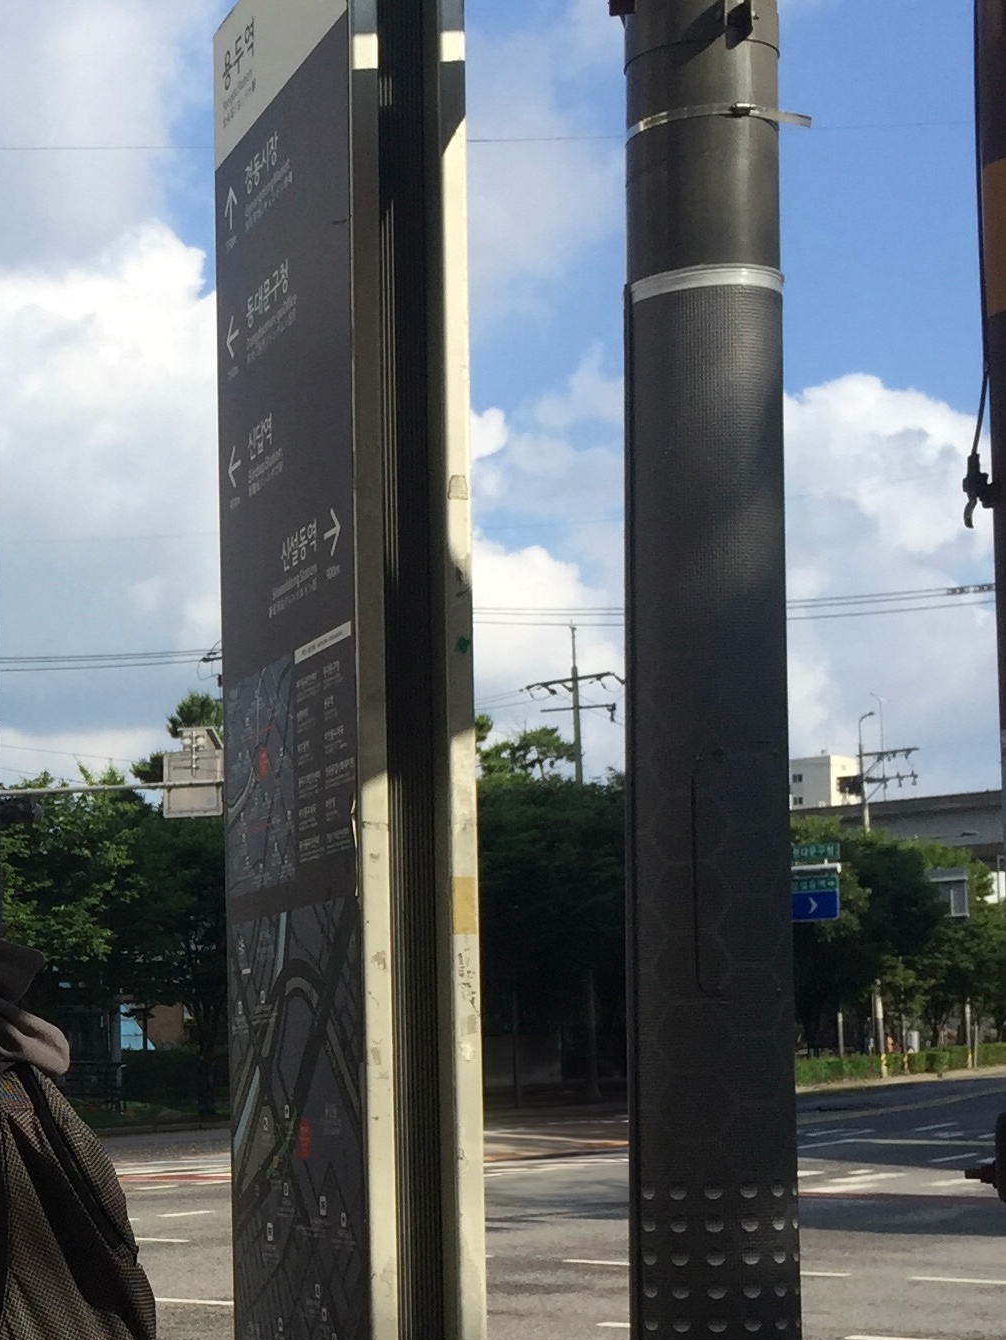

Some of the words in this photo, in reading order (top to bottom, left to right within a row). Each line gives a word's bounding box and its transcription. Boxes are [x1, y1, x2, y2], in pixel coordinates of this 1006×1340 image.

[222, 16, 254, 91] 용두역
[244, 130, 279, 195] 경동시장
[246, 258, 289, 328] 동대문구청
[248, 412, 272, 461] 신답역
[281, 518, 317, 572] 신설동역
